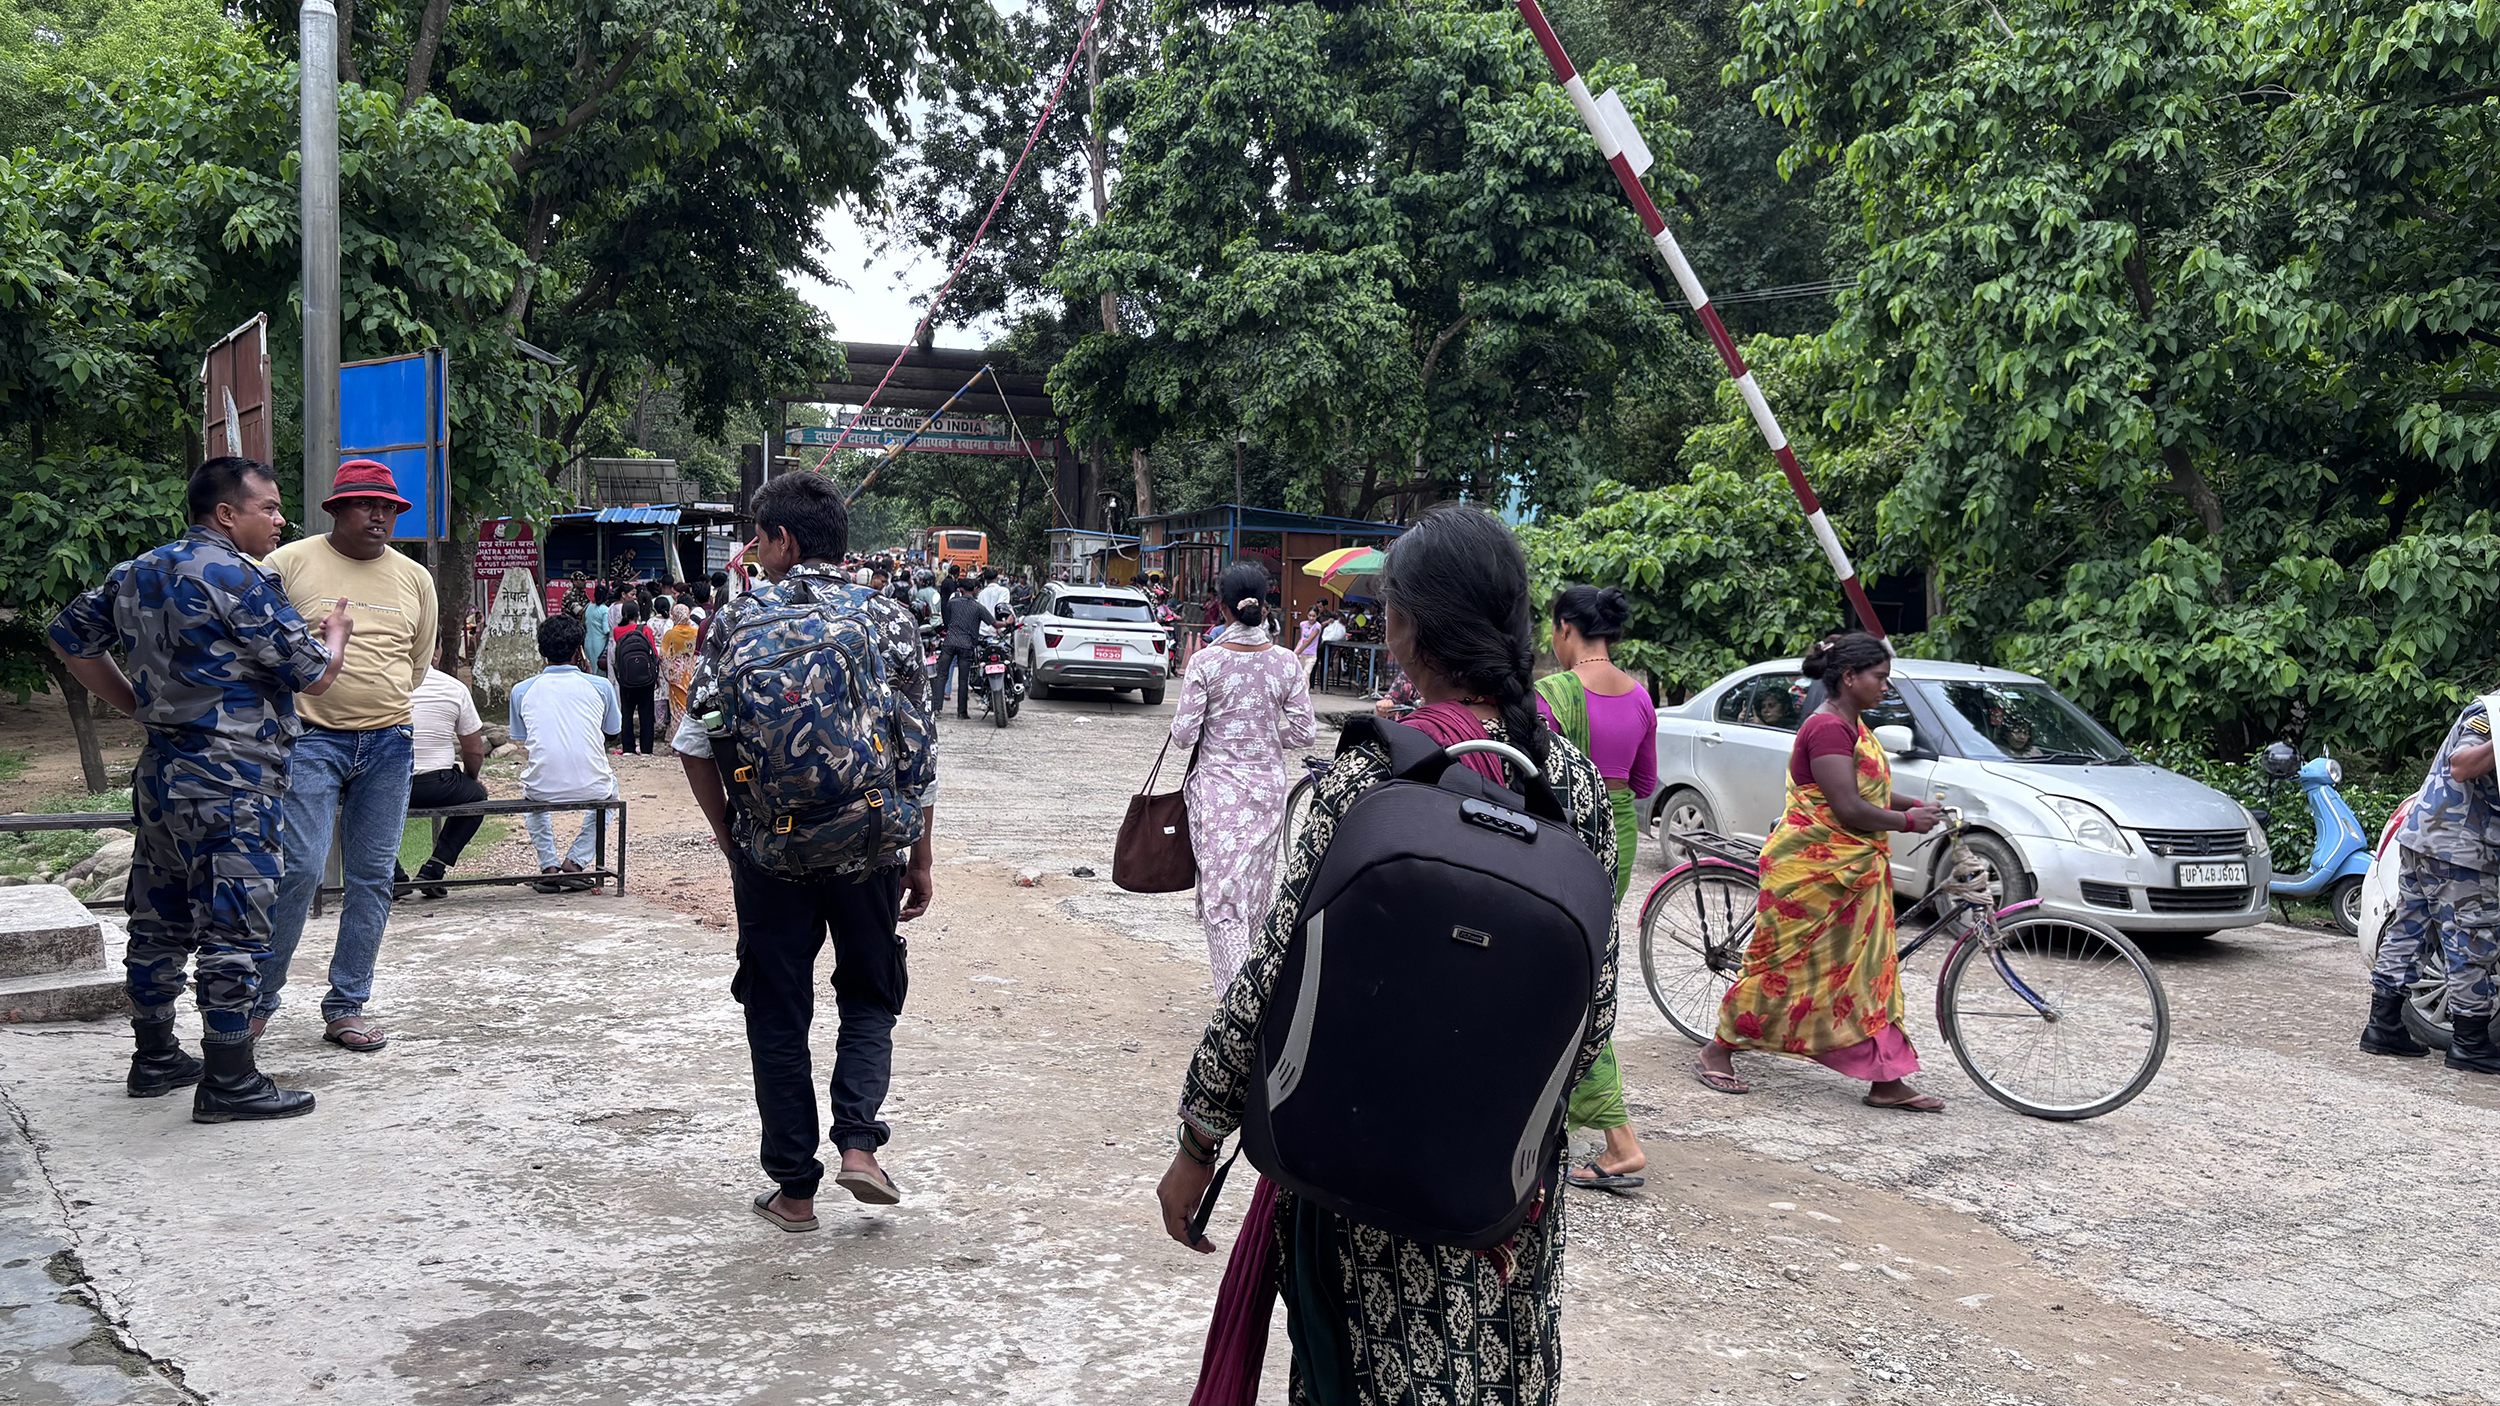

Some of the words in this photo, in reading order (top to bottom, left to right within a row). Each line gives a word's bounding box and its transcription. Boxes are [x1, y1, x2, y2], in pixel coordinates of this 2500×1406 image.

[859, 415, 922, 430] WELCOME
[926, 419, 943, 430] TO
[947, 420, 983, 433] INDIA
[848, 434, 880, 445] टाइगर
[916, 436, 953, 449] आपका
[956, 439, 990, 451] स्वागत
[494, 539, 516, 548] सीमा
[477, 568, 505, 576] स्वाग
[502, 587, 529, 603] नेपाल
[780, 699, 814, 714] FAMILIAR
[2185, 867, 2246, 882] UP14BJ6021
